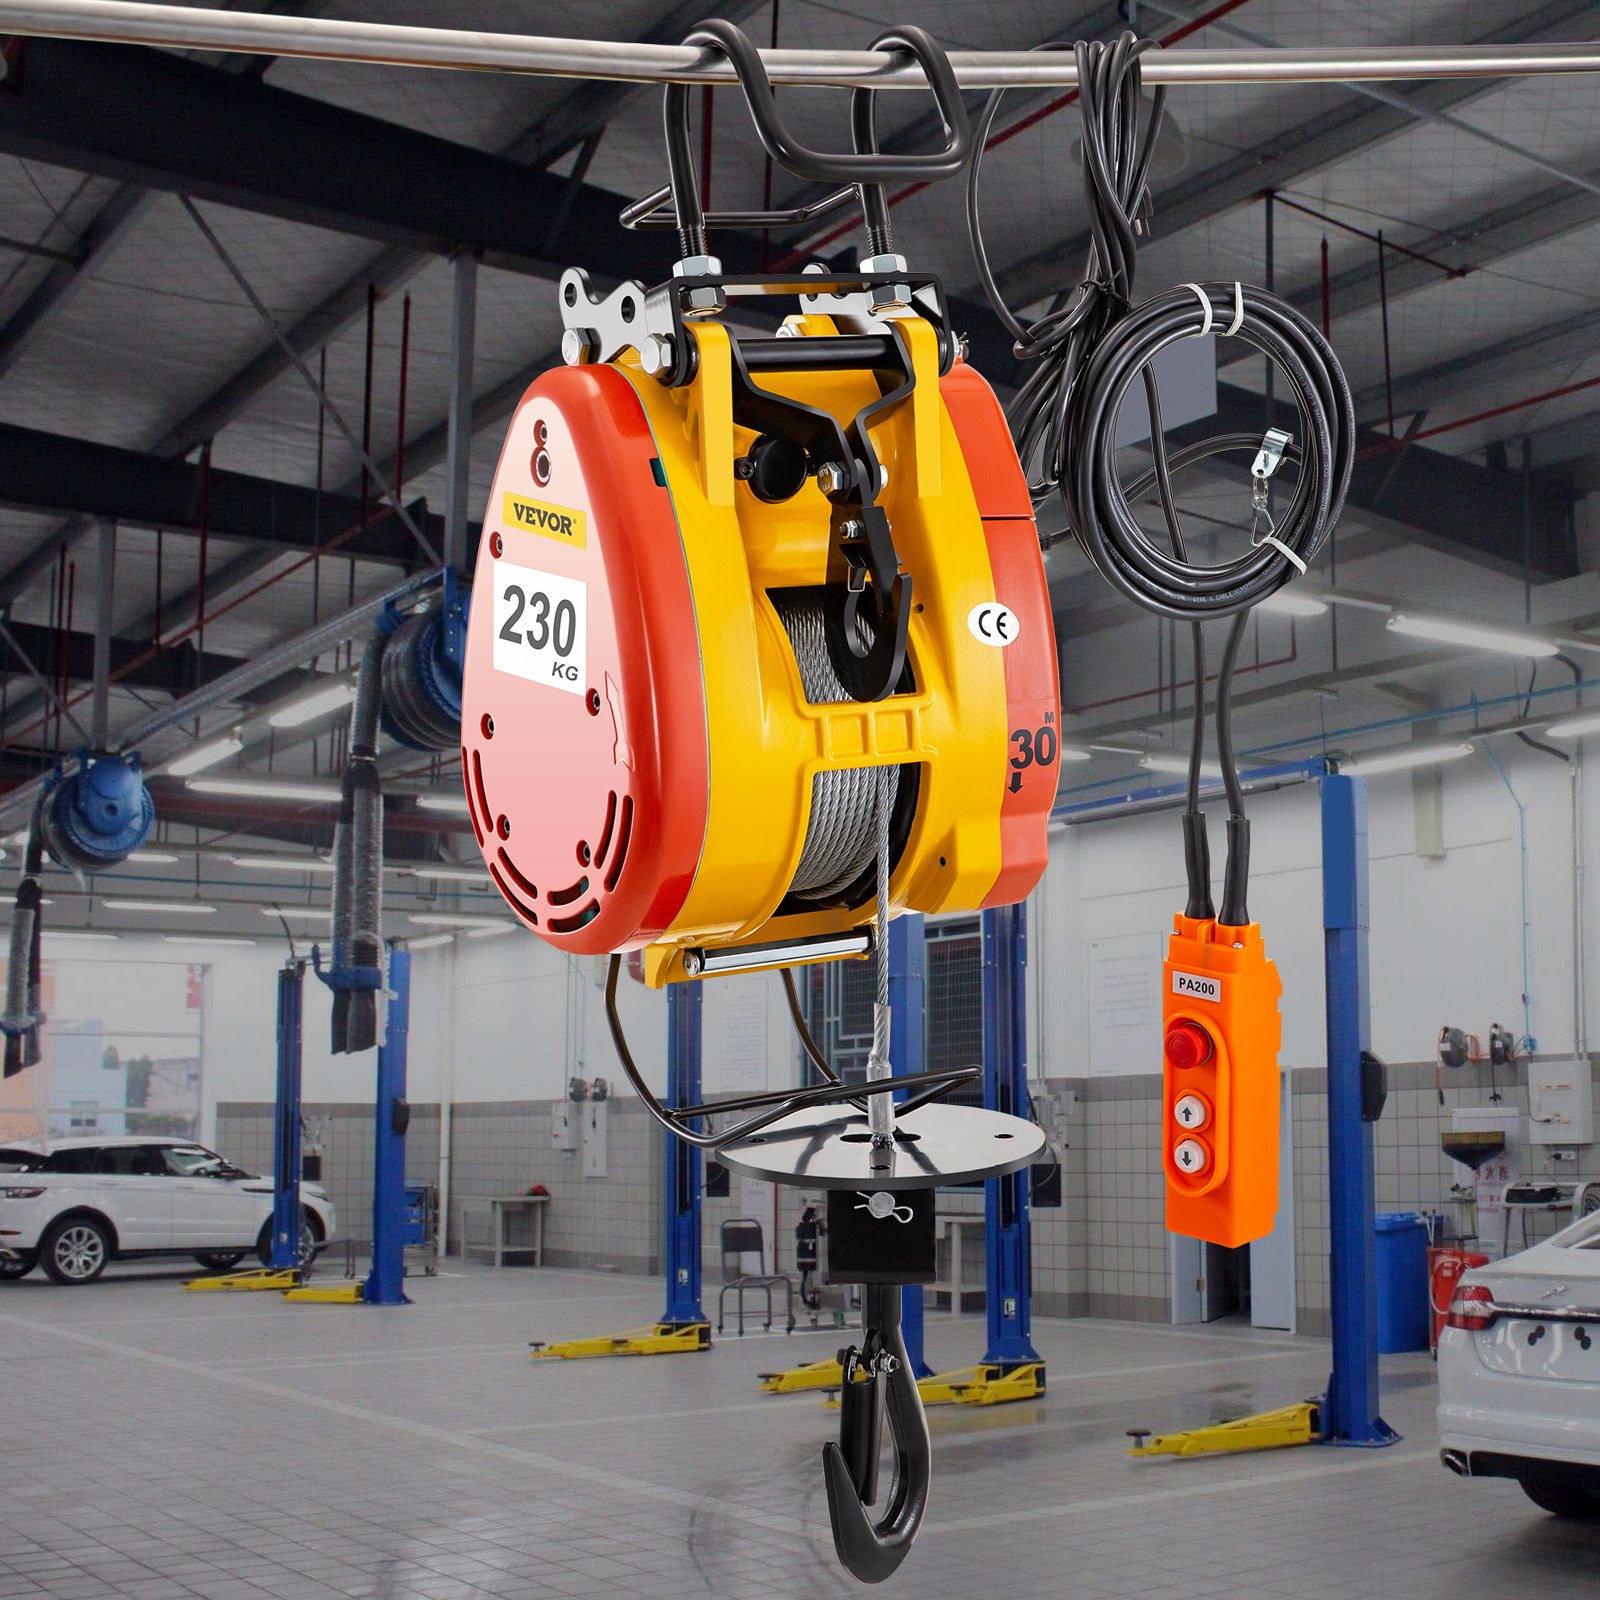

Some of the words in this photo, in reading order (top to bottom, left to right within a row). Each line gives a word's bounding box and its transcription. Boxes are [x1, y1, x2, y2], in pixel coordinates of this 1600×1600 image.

[513, 502, 573, 536] VEVOR
[499, 584, 576, 658] 230
[978, 609, 1008, 640] CE
[551, 661, 579, 682] KG
[1044, 711, 1055, 724] M
[1010, 726, 1057, 769] 30
[1178, 976, 1216, 996] PA200
